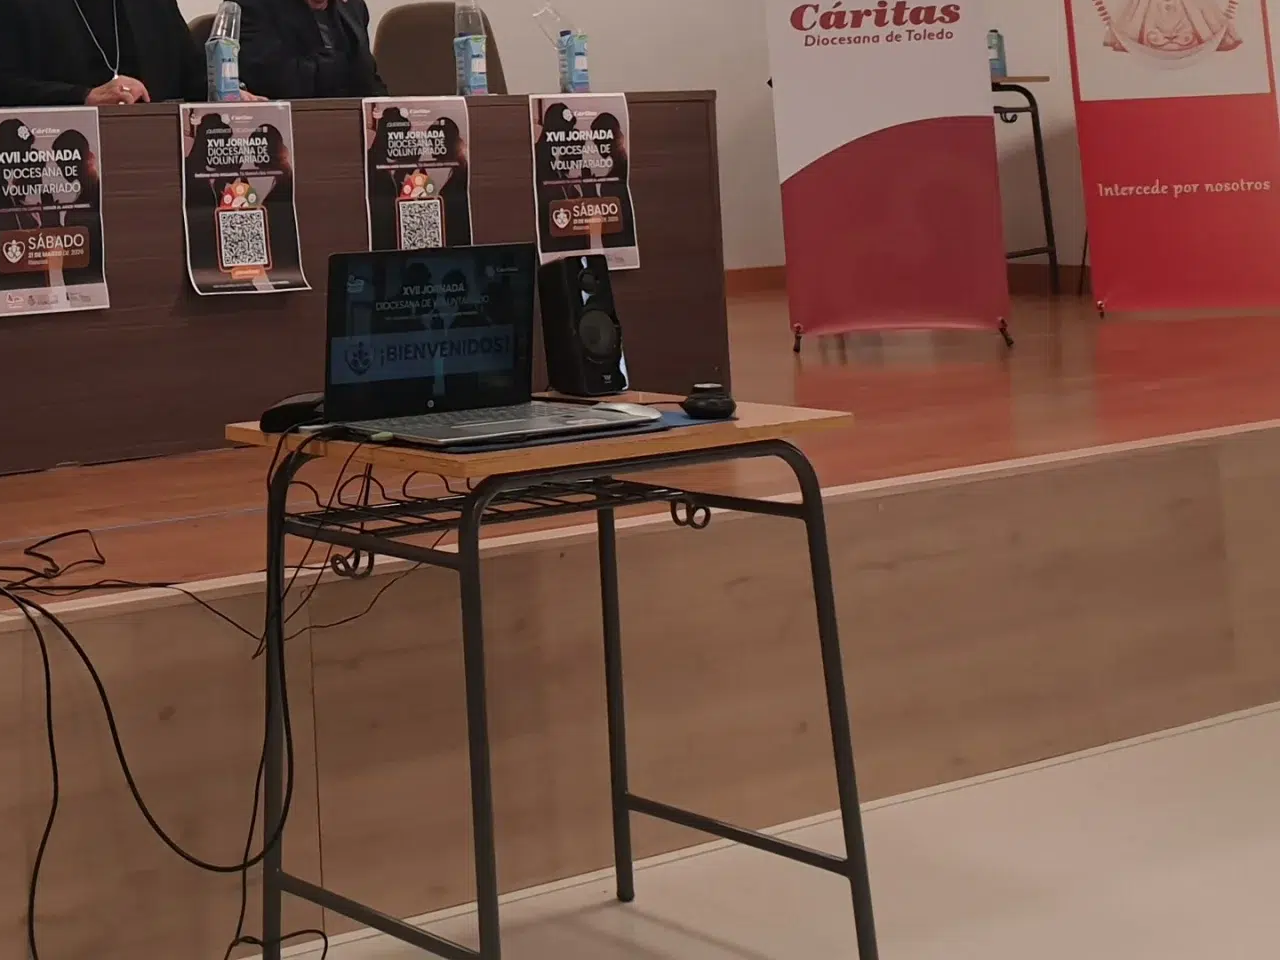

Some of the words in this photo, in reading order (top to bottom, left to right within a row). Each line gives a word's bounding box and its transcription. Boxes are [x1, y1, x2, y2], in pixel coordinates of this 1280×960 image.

[790, 0, 961, 31] Cáritas
[804, 34, 880, 47] Diocesana
[885, 31, 902, 43] de
[906, 28, 954, 41] Toledo
[387, 132, 404, 140] XVII
[405, 130, 445, 139] JORNADA
[546, 131, 566, 142] XVII
[566, 129, 614, 141] JORNADA
[207, 139, 224, 147] XVII
[226, 138, 268, 147] JORNADA
[388, 140, 433, 149] DIOCESANA
[434, 139, 445, 147] DE
[22, 149, 82, 163] JORNADA
[207, 147, 256, 156] DIOCESANA
[257, 146, 268, 154] DE
[386, 146, 447, 157] VOLUNTARIADO
[551, 145, 599, 156] DIOCESANA
[600, 144, 611, 153] DE
[206, 155, 270, 165] VOLUNTARIADO
[550, 158, 614, 171] VOLUNTARIADO
[3, 167, 64, 180] DIOCESANA
[65, 165, 79, 177] DE
[1, 182, 81, 197] VOLUNTARIADO
[1098, 179, 1169, 197] Intercede
[1173, 183, 1199, 198] por
[1205, 178, 1271, 193] nosotros
[573, 202, 618, 217] SÁBADO
[28, 233, 84, 250] SÁBADO
